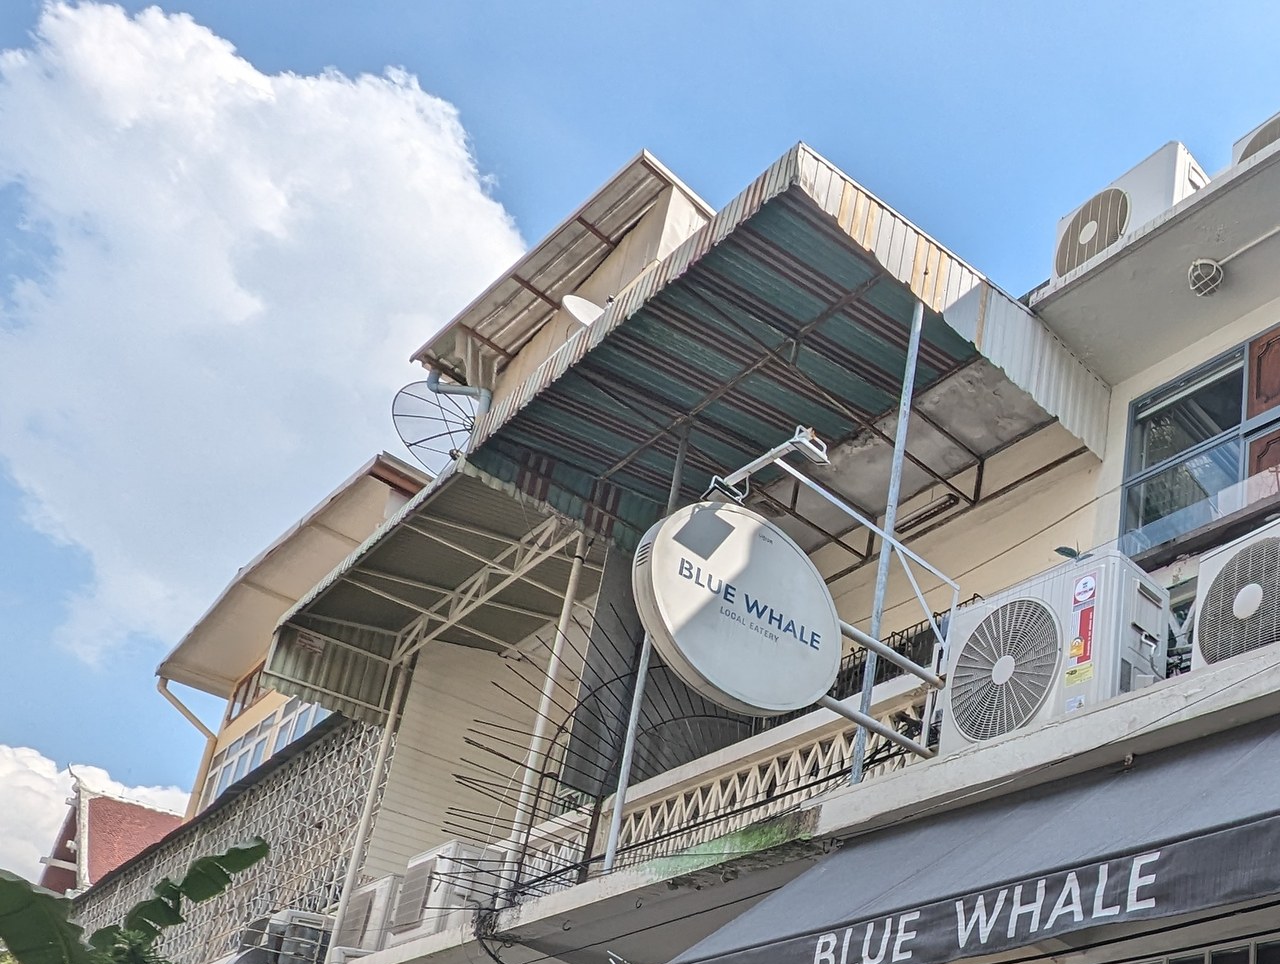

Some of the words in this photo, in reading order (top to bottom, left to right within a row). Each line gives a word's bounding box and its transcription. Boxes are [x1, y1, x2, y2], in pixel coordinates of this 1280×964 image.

[678, 557, 737, 605] BLUE
[744, 593, 822, 651] WHALE
[719, 605, 746, 626] LOCAL
[749, 621, 780, 644] EATERY
[954, 850, 1161, 950] WHALE
